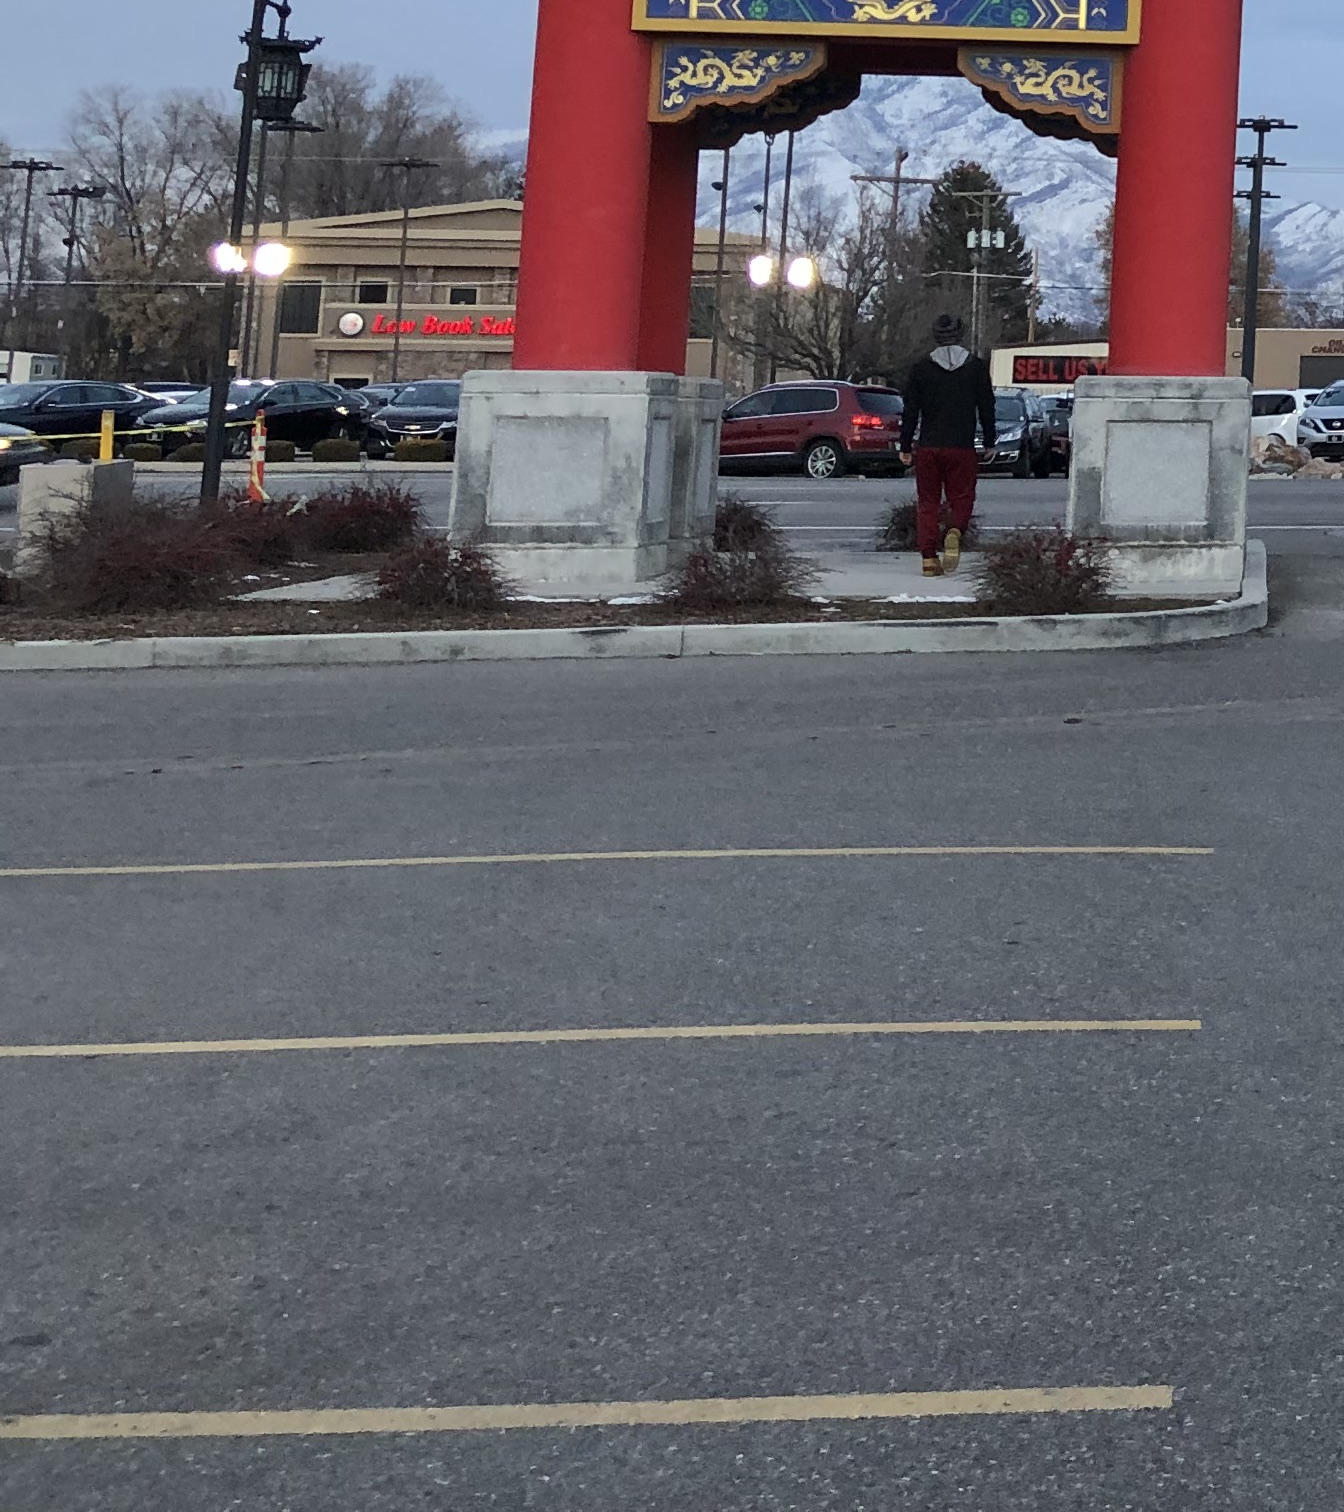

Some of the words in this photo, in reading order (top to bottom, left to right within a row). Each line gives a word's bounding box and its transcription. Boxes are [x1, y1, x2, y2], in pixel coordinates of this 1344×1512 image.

[371, 313, 416, 334] Low
[421, 315, 474, 335] Book
[1015, 359, 1058, 380] SELL
[1064, 359, 1088, 380] US
